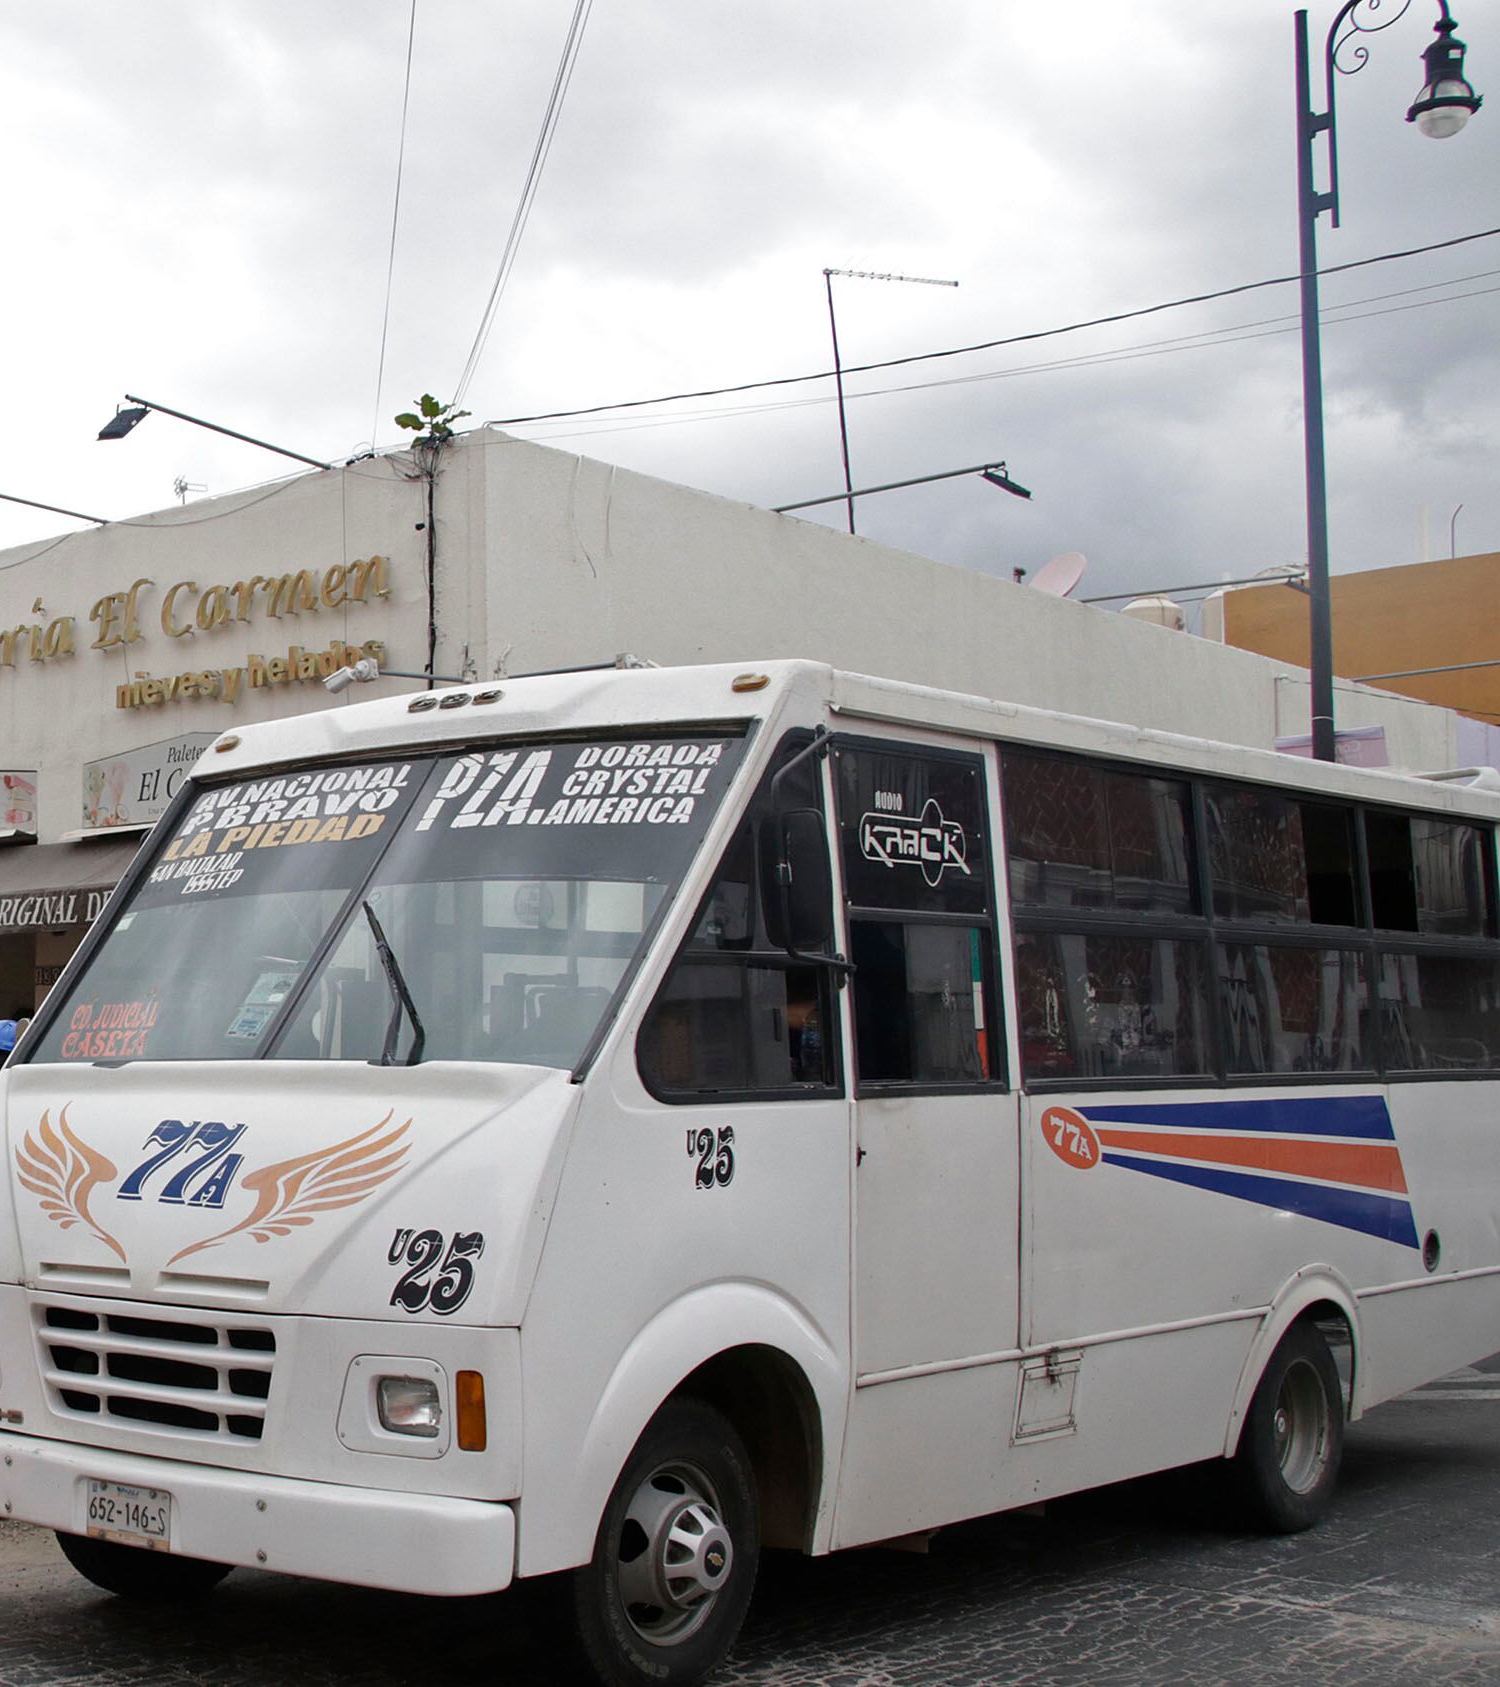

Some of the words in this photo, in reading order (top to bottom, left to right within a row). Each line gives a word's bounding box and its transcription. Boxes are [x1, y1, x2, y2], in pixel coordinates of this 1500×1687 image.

[90, 577, 155, 650] El
[161, 554, 392, 638] Carmen
[116, 670, 221, 709] nieves
[220, 668, 243, 704] y
[574, 744, 723, 767] DORADA
[137, 768, 161, 802] El
[562, 767, 711, 796] CRYSTAL
[545, 796, 695, 825] AMERICA
[875, 790, 903, 811] AUDIO
[163, 831, 213, 861] LA
[215, 814, 386, 853] PIEDAD
[150, 862, 180, 883] SAN
[173, 852, 244, 879] BALTAZAR
[61, 1030, 149, 1058] CASETA
[1049, 1114, 1093, 1161] 77A
[116, 1119, 249, 1209] 77A
[89, 1496, 167, 1533] 652-146-S
